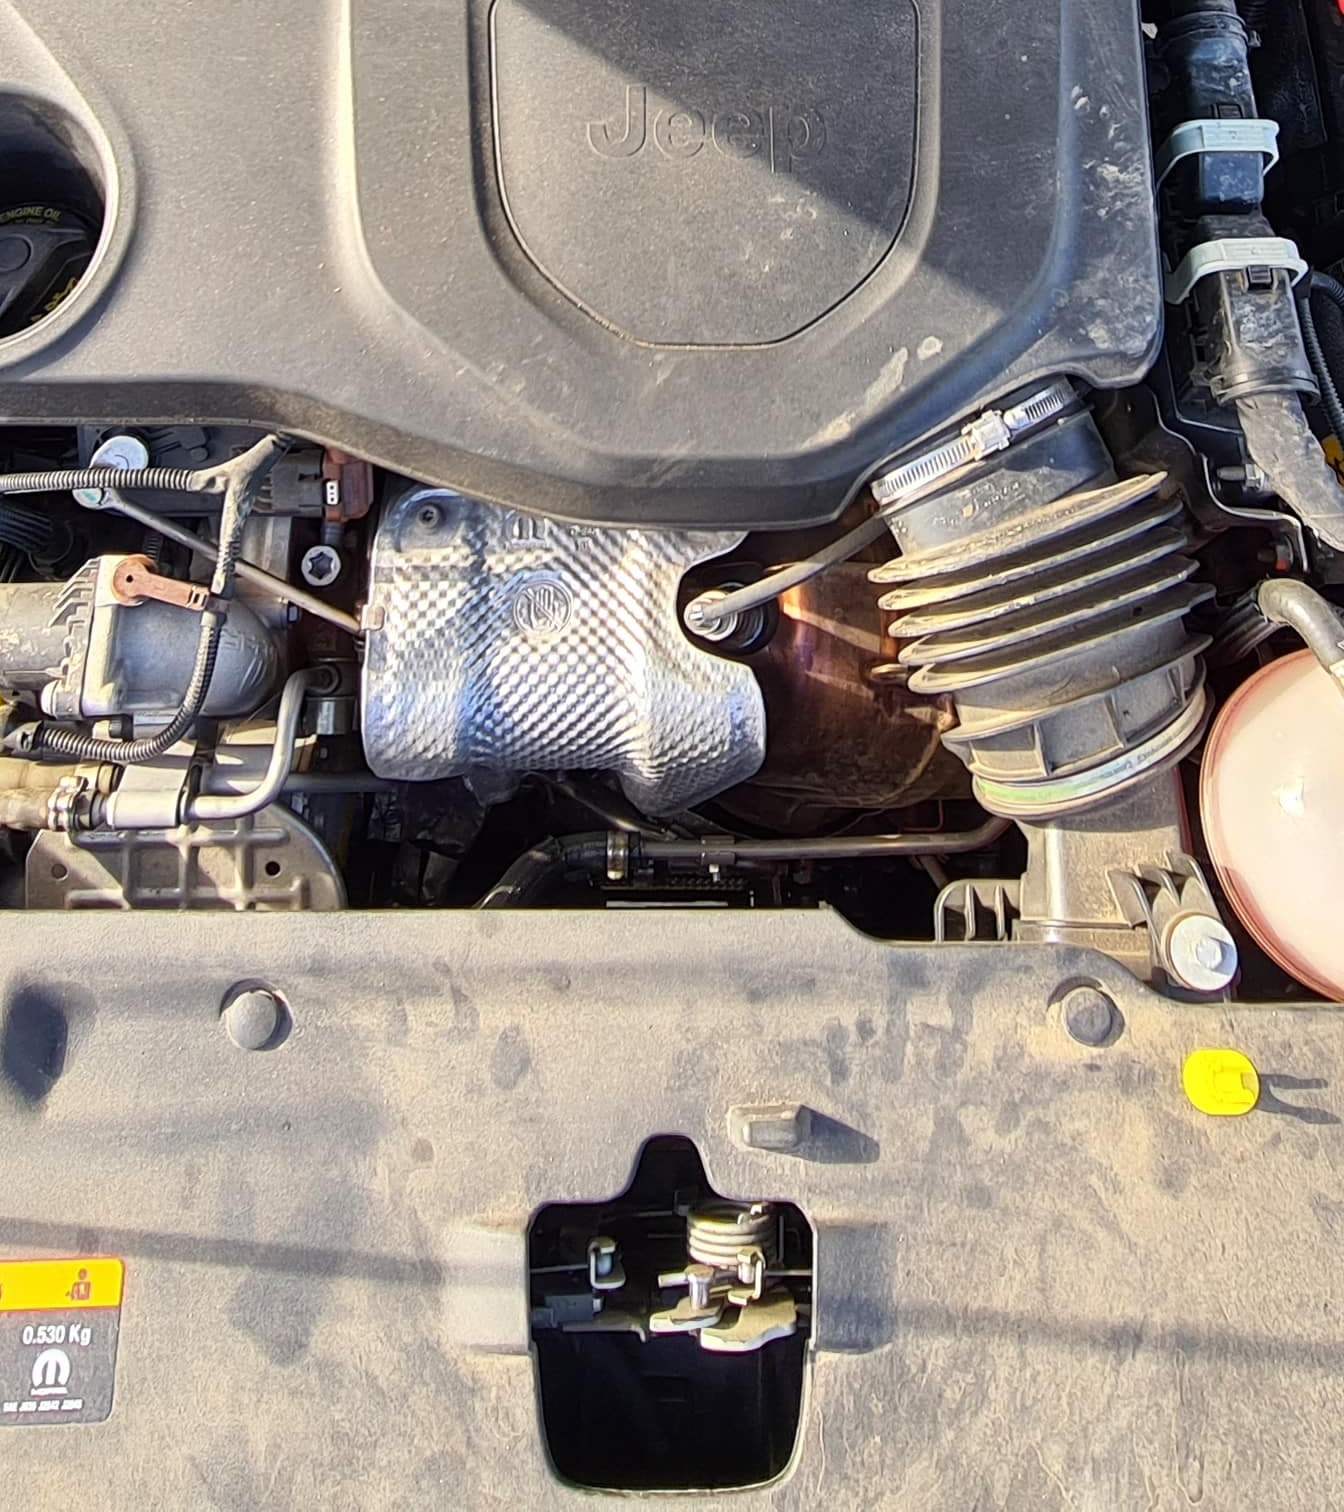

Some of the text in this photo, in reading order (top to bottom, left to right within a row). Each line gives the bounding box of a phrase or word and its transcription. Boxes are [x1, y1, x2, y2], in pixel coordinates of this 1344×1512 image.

[587, 84, 827, 174] Jeep
[0, 206, 43, 223] ENGINE
[43, 207, 62, 222] OIL
[22, 1324, 65, 1346] 0.530
[68, 1322, 92, 1346] Kg
